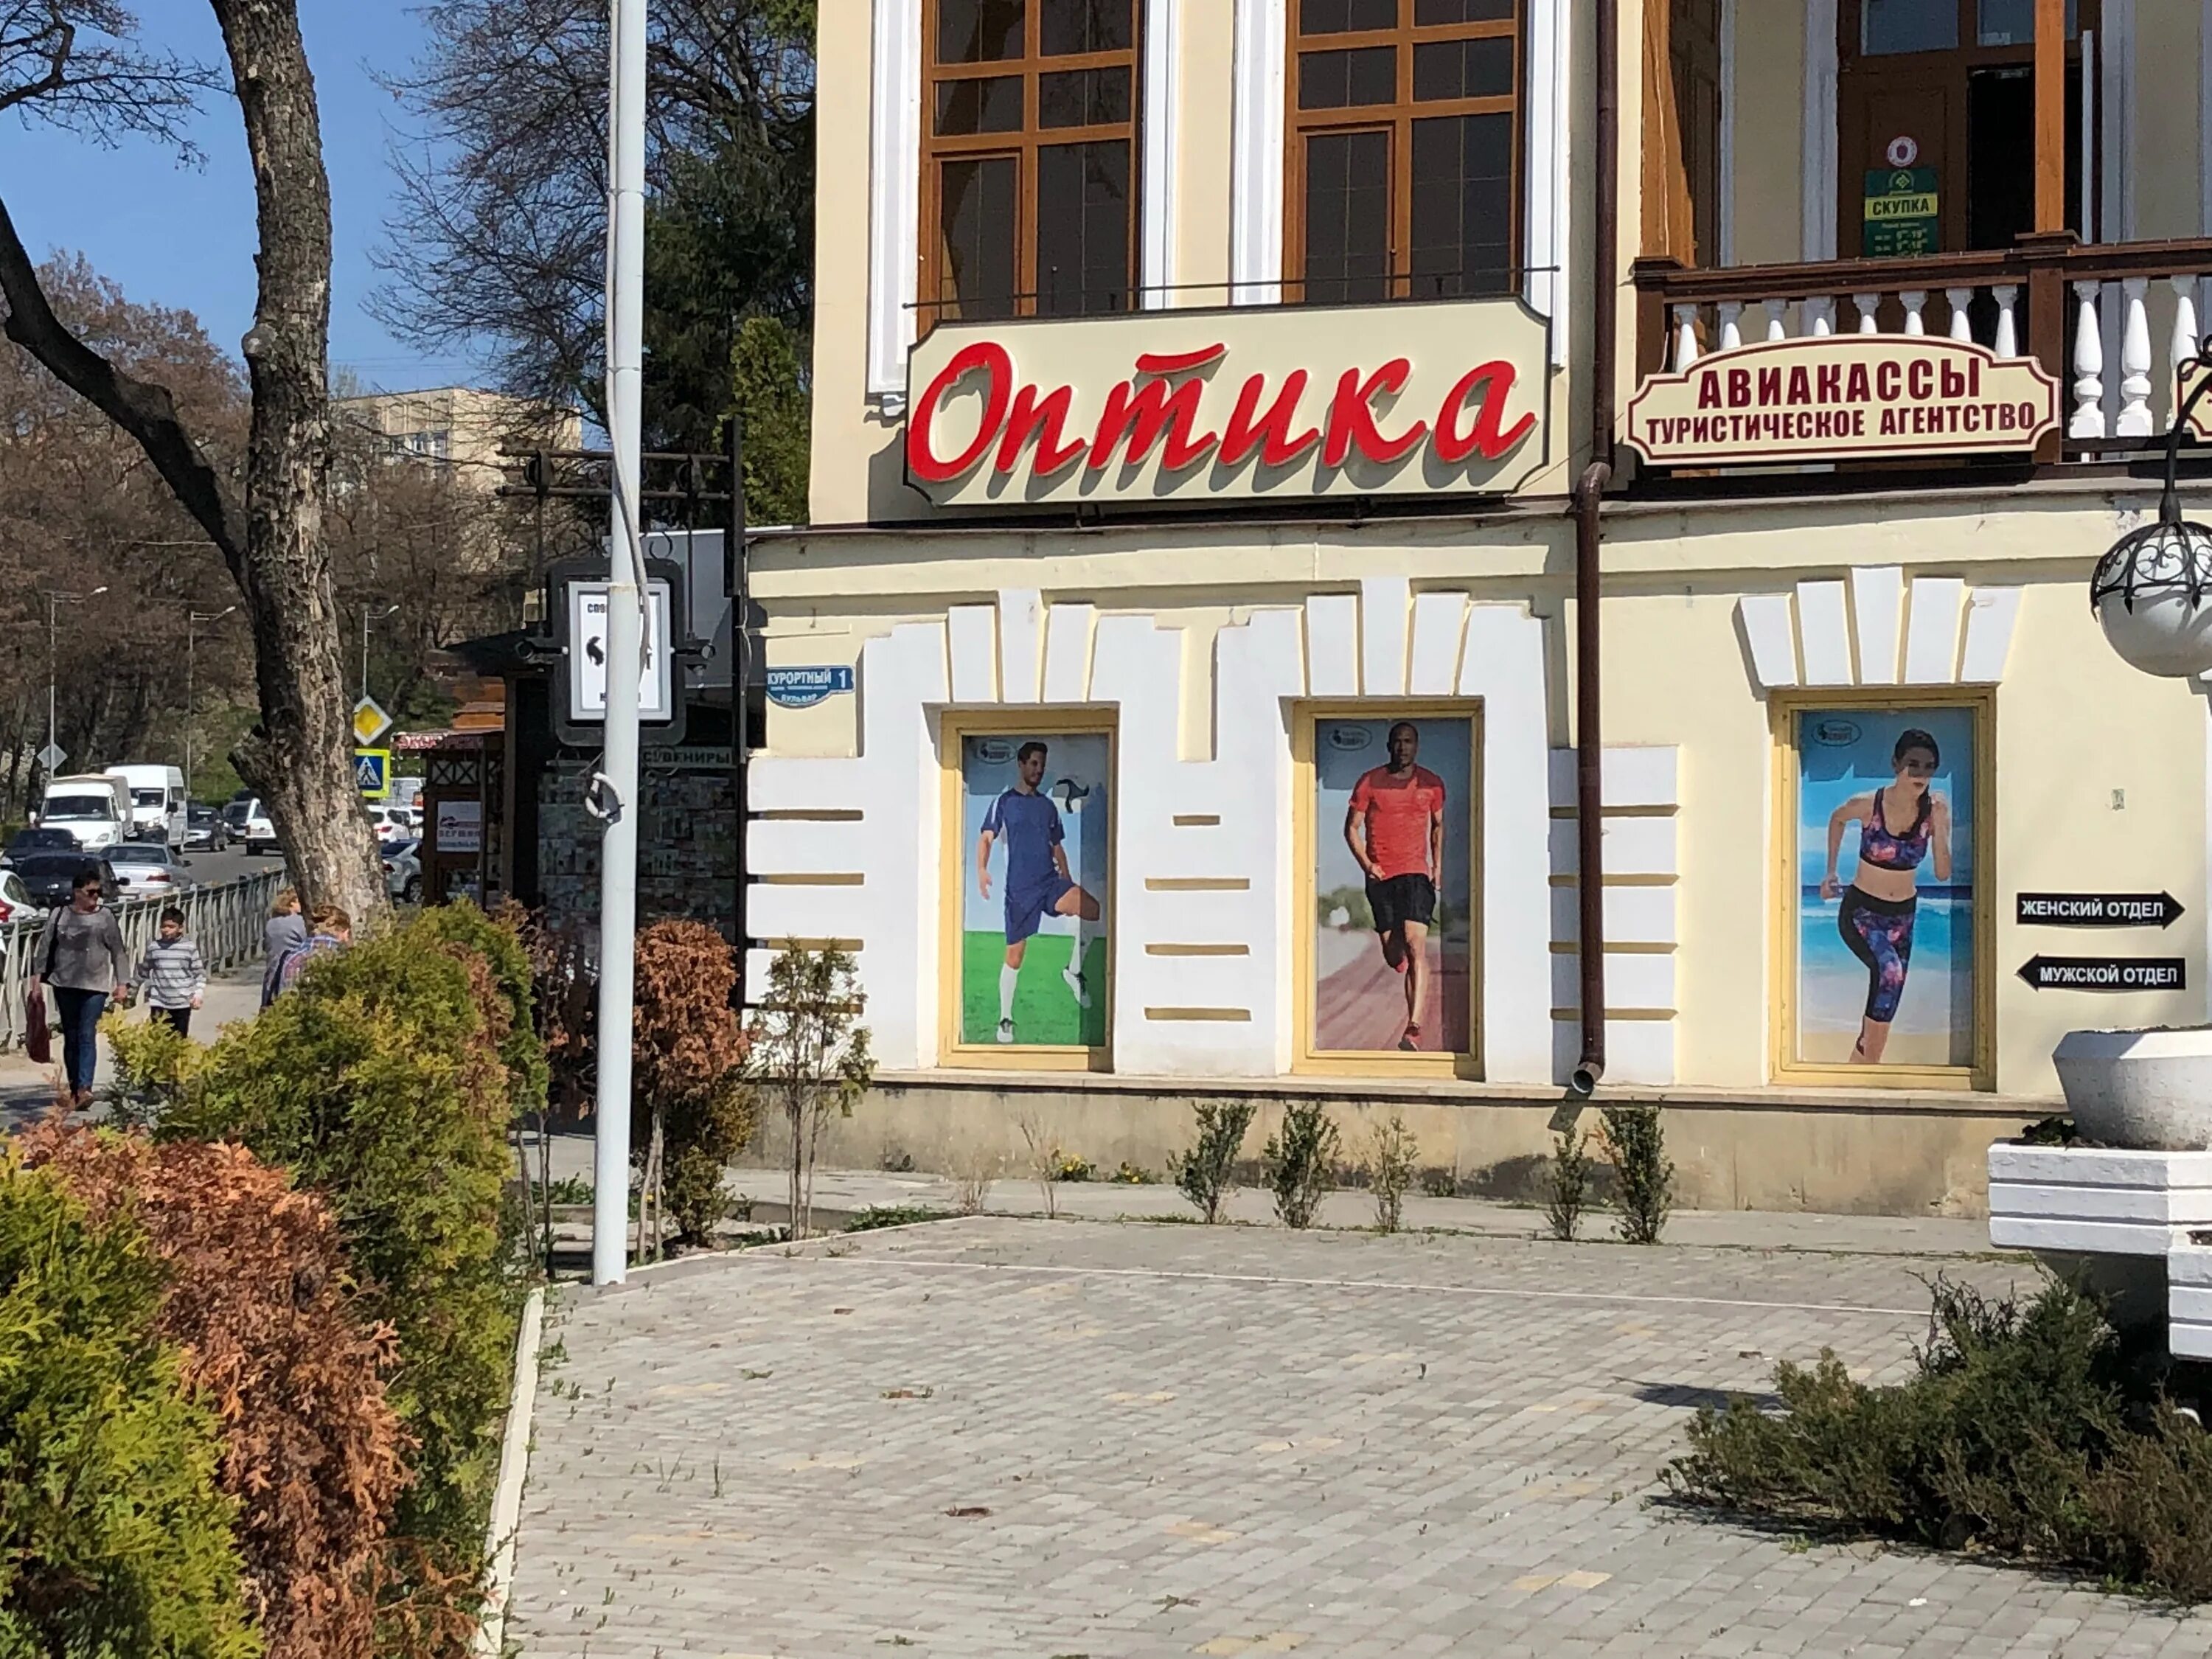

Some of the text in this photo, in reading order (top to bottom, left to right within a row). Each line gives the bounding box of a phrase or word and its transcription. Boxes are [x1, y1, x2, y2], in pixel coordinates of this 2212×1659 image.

[1872, 198, 1930, 215] СКУПКА
[1697, 358, 1980, 409] АВИАКАССЫ
[908, 341, 1537, 482] Оптика
[1646, 402, 2036, 444] ТУРИСТИЧЕСКОЕ АГЕНТСТВО
[768, 669, 846, 689] КУРОРТНЫЙ 1
[643, 751, 730, 764] СУВЕНИРЫ
[2021, 898, 2163, 919] ЖЕНСКИЙ ОТДЕЛ
[2039, 964, 2177, 986] МУЖСКОЙ ОТДЕЛ
